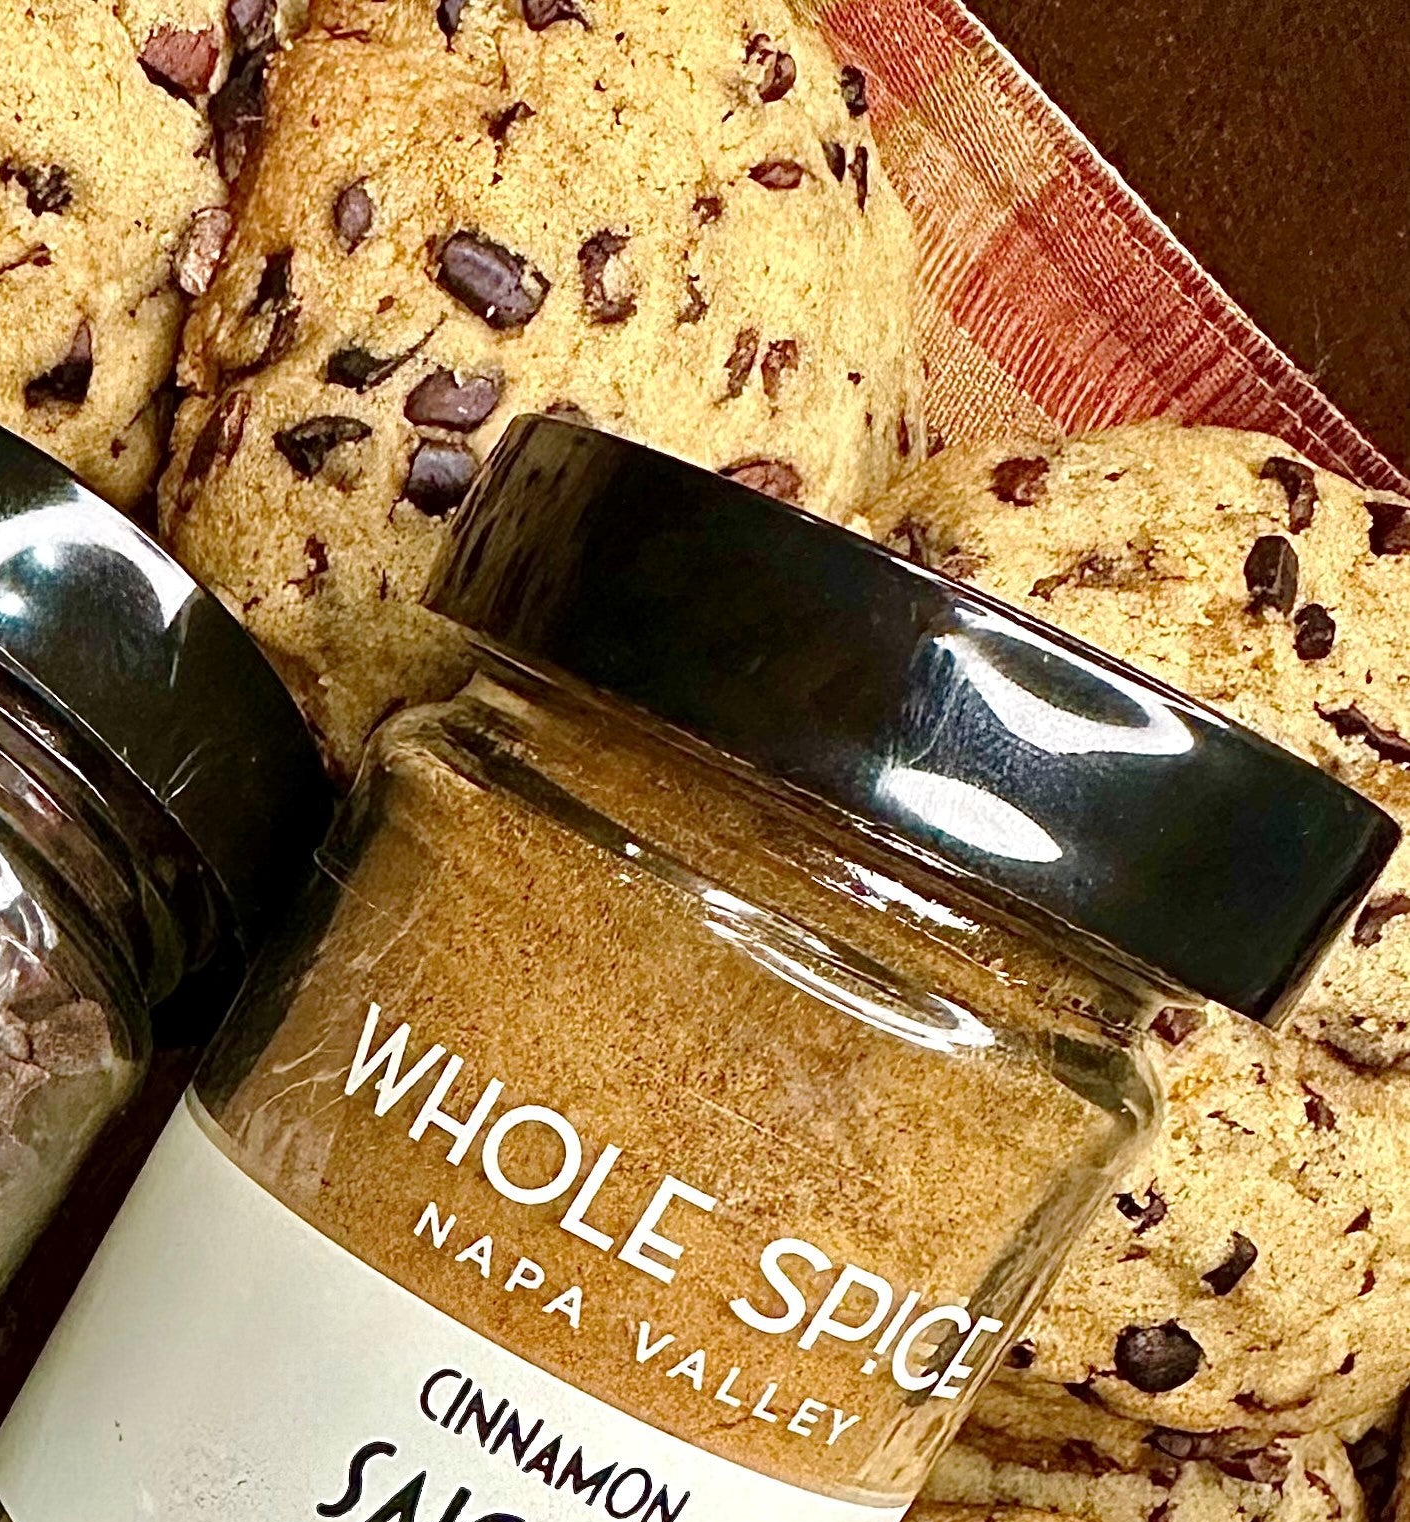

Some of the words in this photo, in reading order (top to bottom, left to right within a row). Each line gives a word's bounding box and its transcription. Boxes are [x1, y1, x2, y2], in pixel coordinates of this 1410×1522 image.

[345, 1002, 716, 1283] WHOLE
[414, 1202, 584, 1328] NAPA
[635, 1321, 859, 1445] VALLEY
